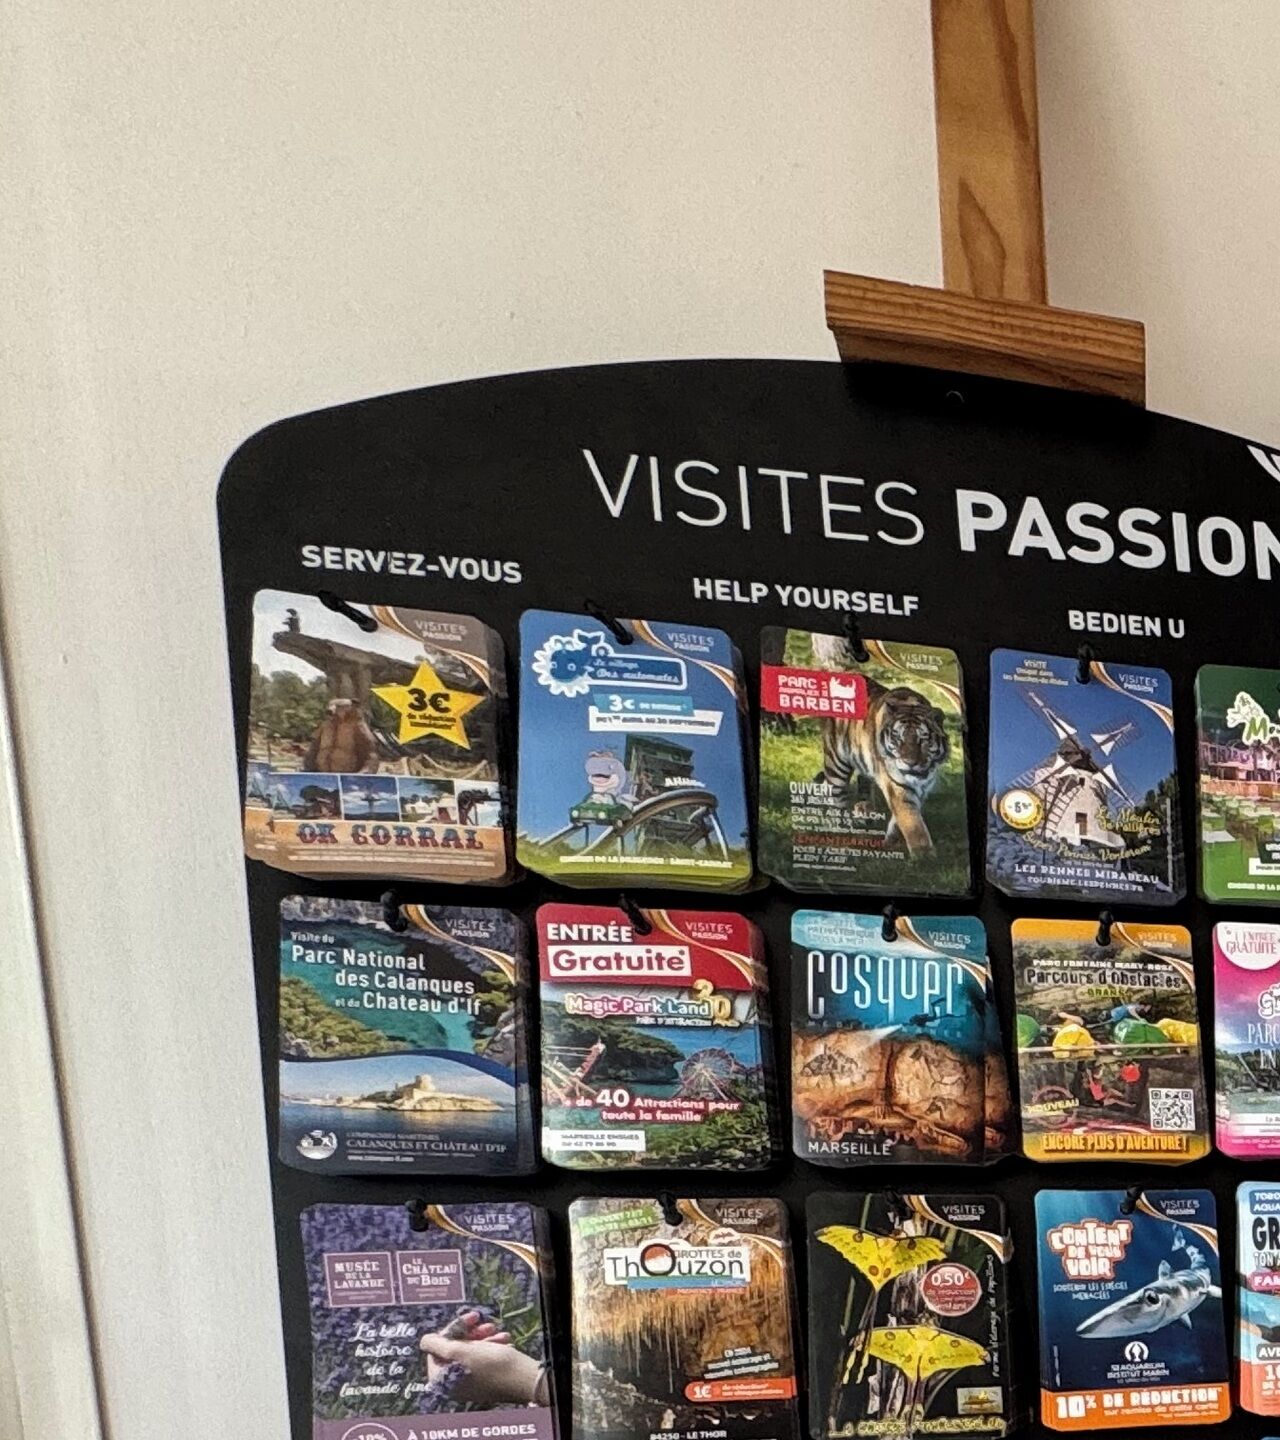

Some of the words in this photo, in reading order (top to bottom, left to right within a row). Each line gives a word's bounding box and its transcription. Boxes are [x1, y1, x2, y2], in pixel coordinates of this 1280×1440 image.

[582, 448, 927, 547] VISITES
[301, 545, 523, 585] SERVEZ-VOUS
[692, 577, 770, 605] HELP
[775, 583, 920, 617] YOURSELF
[1067, 609, 1163, 638] BEDIEN
[1167, 618, 1187, 639] U
[777, 674, 818, 690] PARC
[407, 687, 452, 714] 3€
[778, 696, 857, 714] BARBEN
[546, 920, 634, 943] ENTRÉE
[291, 945, 337, 966] Parc
[342, 948, 427, 973] National
[335, 968, 370, 988] des
[373, 971, 476, 997] Calanques
[1025, 968, 1096, 987] Parcours
[362, 990, 443, 1014] Chateau
[447, 995, 482, 1017] d'If
[568, 994, 619, 1015] Magic
[622, 999, 664, 1015] Park
[667, 998, 711, 1016] Land
[806, 1140, 893, 1157] MARSEILLE
